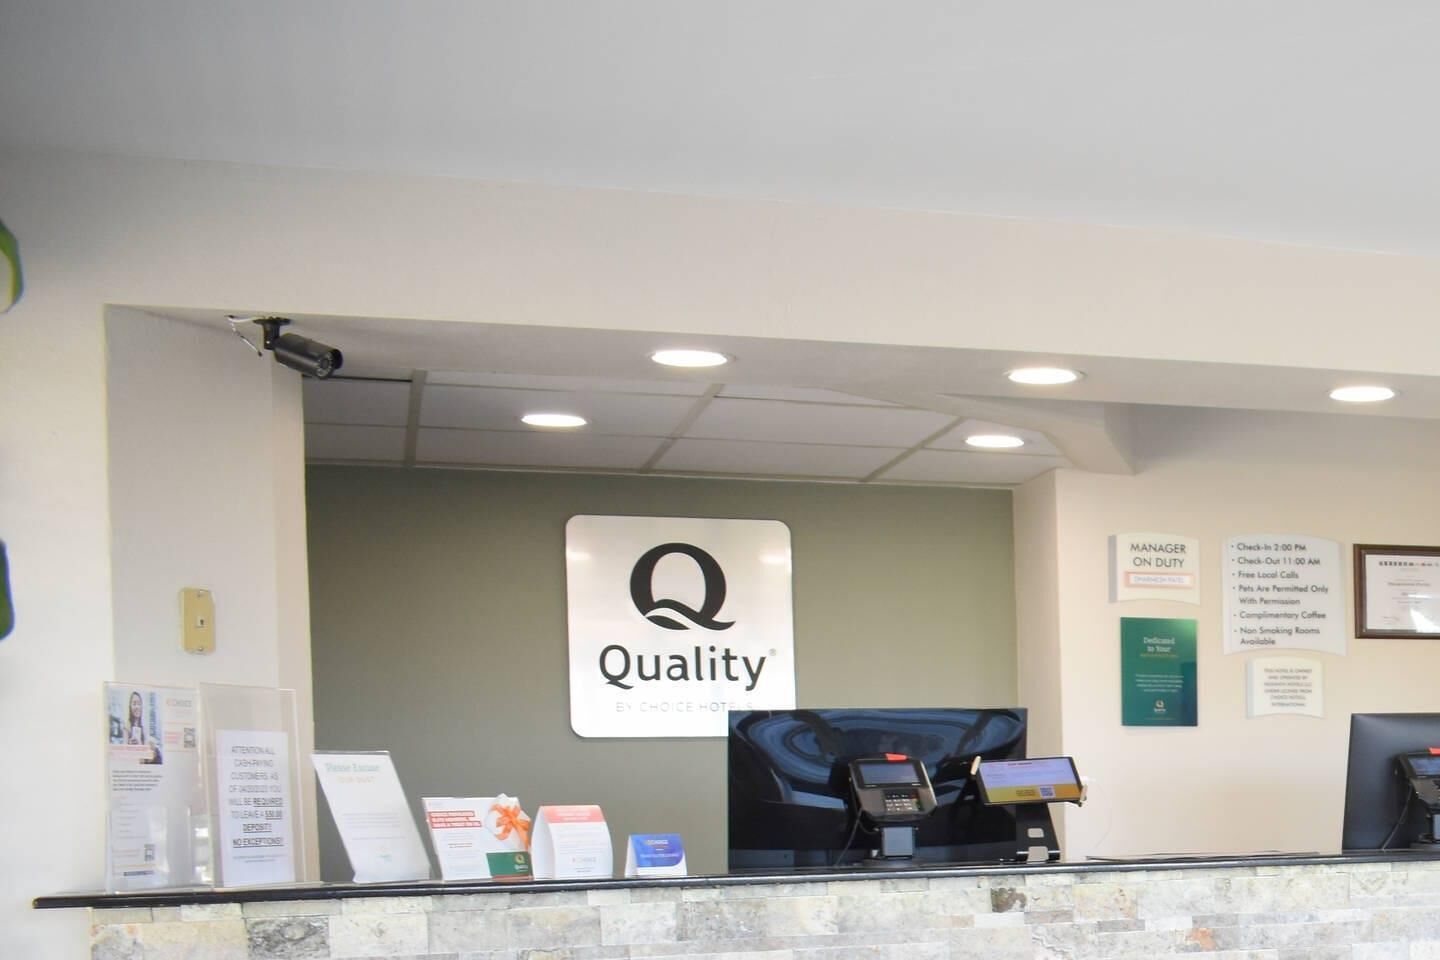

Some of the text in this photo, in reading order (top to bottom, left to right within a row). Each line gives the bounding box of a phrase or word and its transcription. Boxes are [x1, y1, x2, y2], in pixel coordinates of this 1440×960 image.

[1130, 543, 1187, 554] MANAGER
[1236, 542, 1307, 551] Check-In 2:00 PM
[1132, 556, 1185, 568] ON DUTY
[1237, 556, 1321, 566] Check-Out 11:00 AM
[1238, 570, 1300, 579] Free Local Calls
[629, 542, 737, 631] Q
[1238, 584, 1329, 594] Pets Are Permitted Only
[1239, 597, 1301, 605] With Permission
[1239, 611, 1327, 620] Complimentary Coffee
[1240, 626, 1321, 636] Non Smoking Rooms
[1240, 638, 1276, 646] Available
[599, 645, 767, 692] Quality
[616, 702, 753, 712] BY CHOICE HOTES
